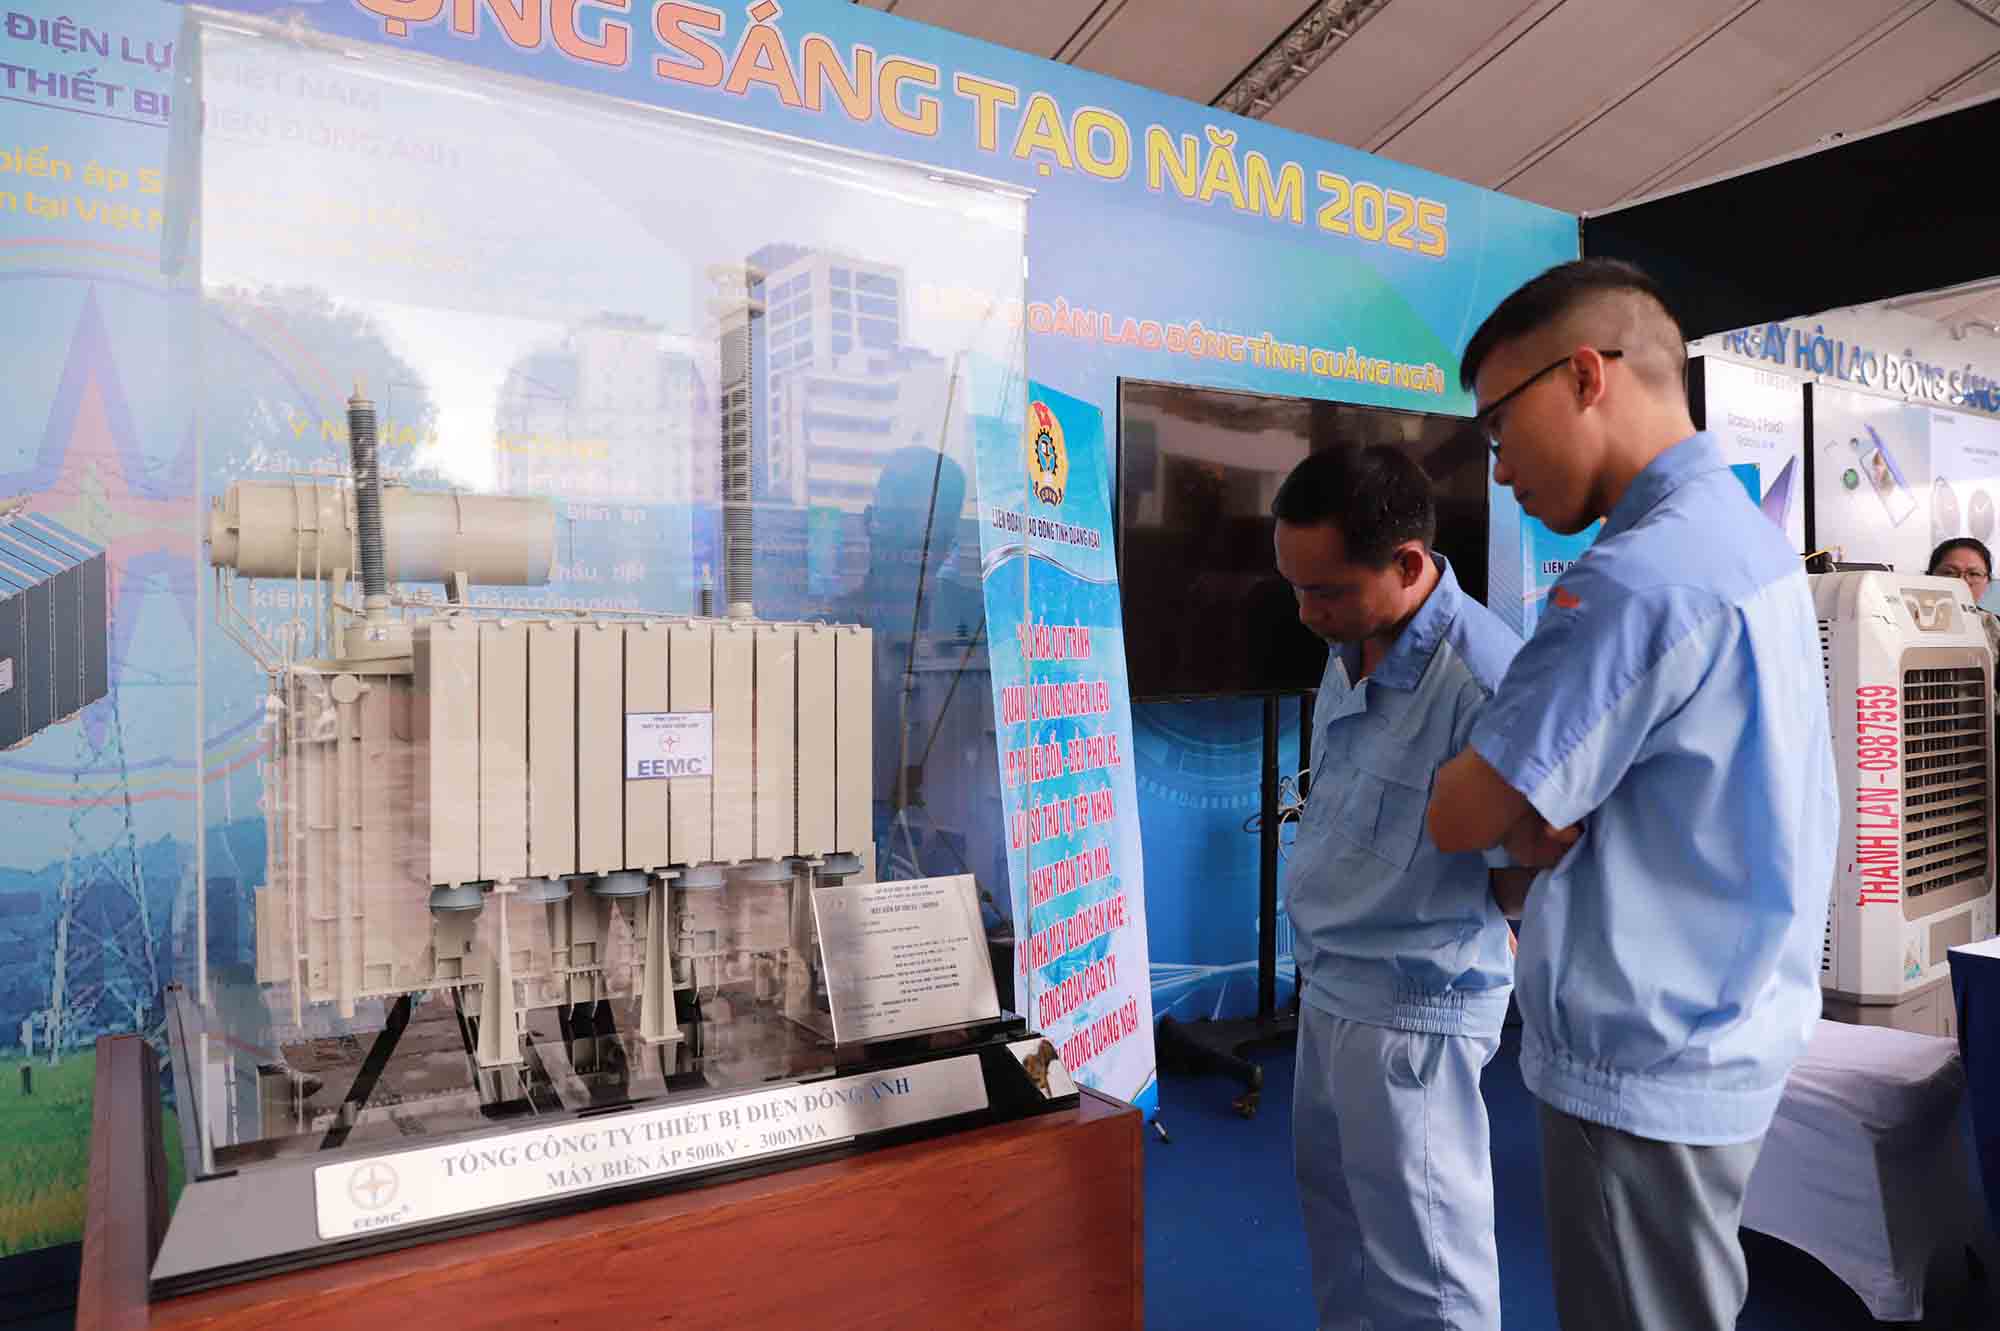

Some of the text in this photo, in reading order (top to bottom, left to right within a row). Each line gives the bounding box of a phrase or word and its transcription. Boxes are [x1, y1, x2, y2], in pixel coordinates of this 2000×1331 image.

[4, 11, 110, 58] ĐIỆN
[121, 35, 174, 73] LỰ
[0, 62, 127, 108] THIẾT
[655, 0, 939, 137] SÁNG
[954, 70, 1131, 181] TẠO
[1146, 124, 1304, 225] NĂM
[1317, 169, 1449, 257] 2025
[1027, 296, 1097, 337] OÀN
[1101, 312, 1161, 351] LAO
[1311, 346, 1392, 386] QUẢNG
[1837, 340, 1879, 387] LAO
[1855, 685, 1899, 771] 0987559
[637, 757, 703, 776] EEMC
[1855, 787, 1900, 829] LAN
[1032, 864, 1055, 908] HANH
[1855, 836, 1900, 907] THANH
[1106, 953, 1118, 987] TY
[442, 1146, 518, 1177] TỔNG
[524, 1133, 599, 1162] CÔNG
[602, 1126, 635, 1148] TY
[640, 1107, 714, 1144] THIẾT
[719, 1110, 742, 1132] BỊ
[869, 1076, 914, 1106] ANH
[547, 1160, 600, 1190] MÁY
[601, 1155, 651, 1180] BIẾN
[655, 1147, 682, 1170] ÁP
[686, 1137, 739, 1165] 500kV
[758, 1122, 828, 1151] 300MVA
